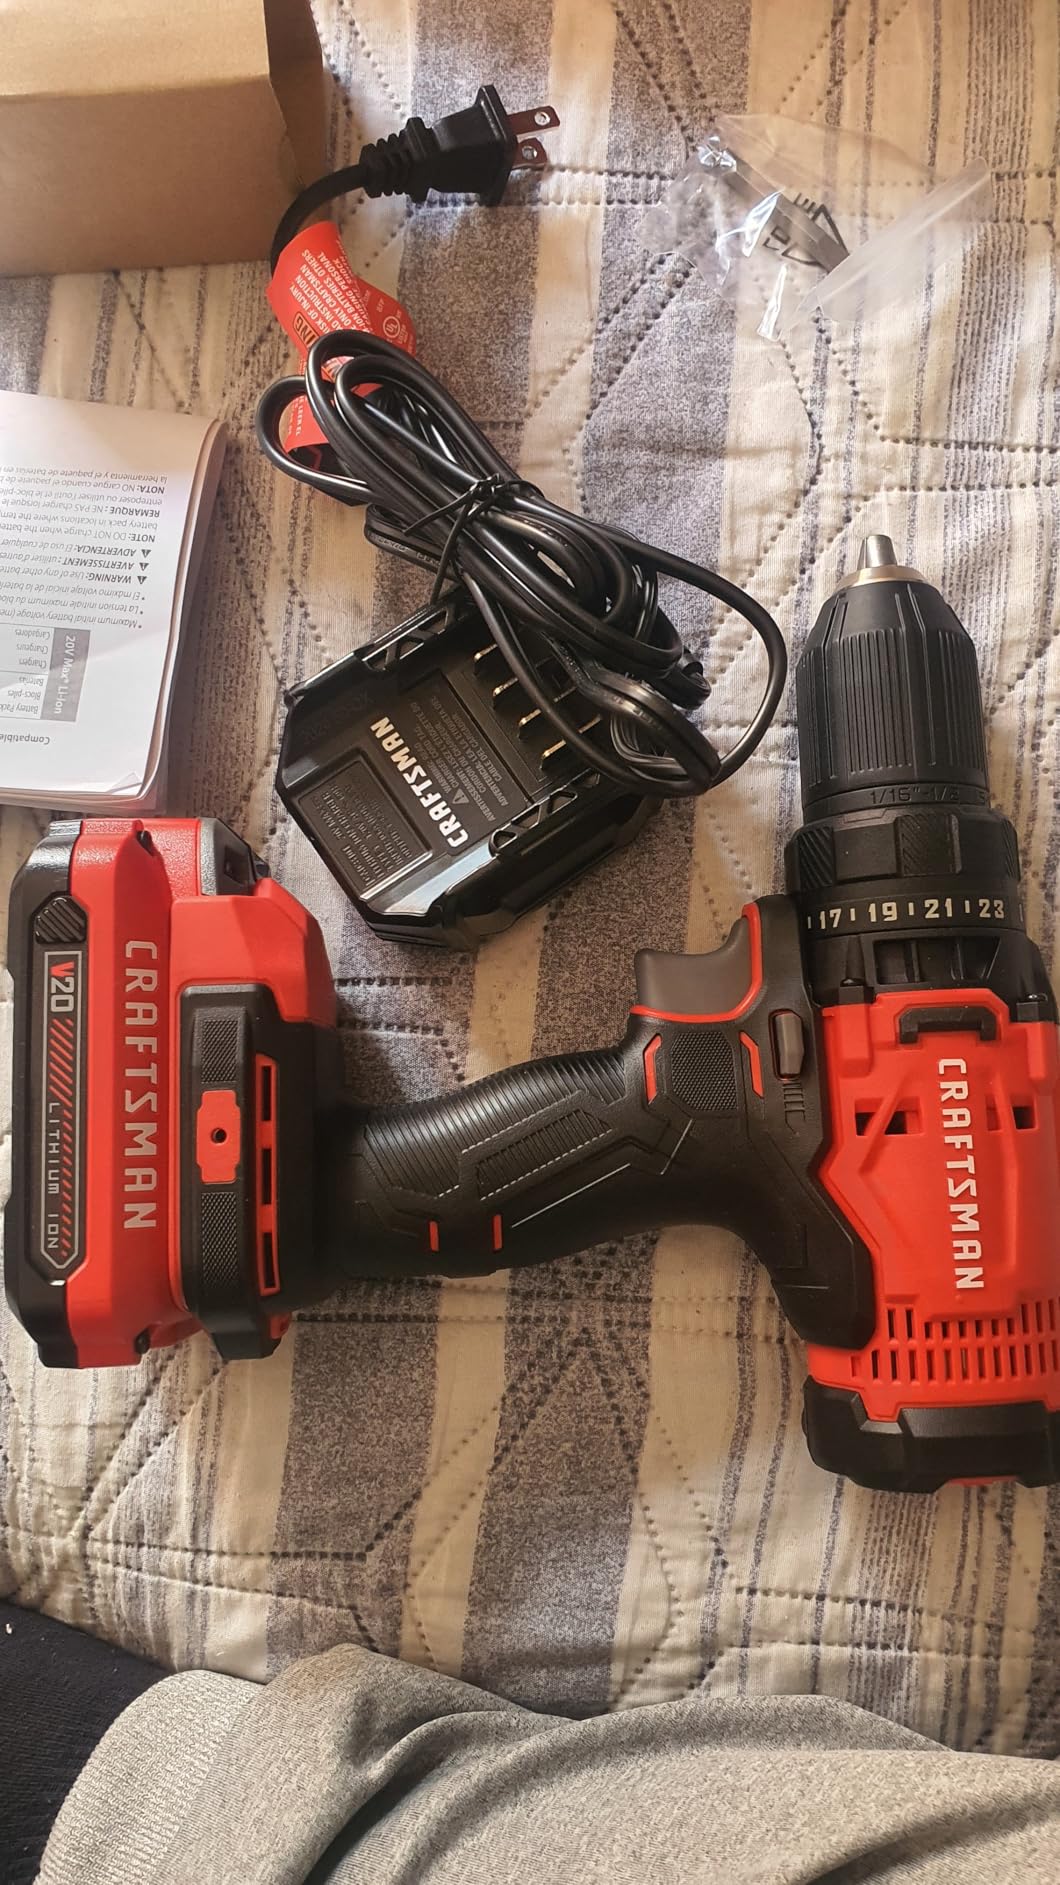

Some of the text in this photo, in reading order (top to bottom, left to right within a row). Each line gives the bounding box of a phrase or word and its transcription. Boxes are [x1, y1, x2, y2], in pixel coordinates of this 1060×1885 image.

[300, 248, 326, 277] OTHERS
[316, 251, 348, 290] PERSONAL
[299, 264, 337, 307] CRAFTSMAN
[294, 274, 334, 321] INSTRUCTION
[306, 308, 318, 320] OF
[332, 305, 352, 326] ONLY
[47, 469, 58, 477] de
[109, 473, 158, 483] herramienta
[159, 476, 167, 484] la
[121, 484, 134, 492] NO
[136, 485, 164, 494] NOTA:
[119, 494, 162, 504] entreposer
[73, 504, 90, 512] PAS
[91, 505, 103, 513] NE
[109, 506, 159, 517] REMARQUE
[18, 512, 31, 520] the
[33, 513, 58, 522] where
[60, 515, 96, 525] locations
[98, 518, 105, 526] in
[107, 517, 127, 528] pack
[129, 519, 157, 530] battery
[23, 524, 37, 533] the
[39, 525, 61, 534] when
[63, 526, 91, 537] charge
[93, 530, 111, 538] NOT
[112, 531, 126, 540] DO
[127, 533, 155, 542] NOTE:
[38, 541, 48, 549] de
[74, 544, 136, 556] ADVERTENCIA:
[62, 557, 134, 570] AVERTISSEMENT
[23, 567, 42, 576] other
[69, 571, 84, 579] Use
[85, 572, 131, 583] WARNING:
[25, 583, 33, 591] la
[34, 584, 44, 592] de
[16, 596, 26, 604] du
[132, 591, 140, 599] El
[46, 611, 73, 622] battery
[63, 634, 75, 655] 20V
[457, 737, 469, 749] LA
[441, 749, 459, 769] LISEZ
[463, 747, 478, 762] LEA
[474, 746, 488, 761] DEL
[457, 755, 469, 767] DU
[434, 756, 460, 788] CHARGER
[369, 715, 469, 848] CRAFTSMAN
[472, 759, 509, 807] ADVERTENCIA:
[453, 767, 496, 822] AVERTISSEMENT:
[819, 898, 1005, 930] 17 19 21 23
[49, 962, 74, 1014] V20
[124, 940, 158, 1229] CRAFTSMAN
[46, 1102, 60, 1250] LITHIUM ION
[937, 1058, 984, 1288] CRAFTSMAN
